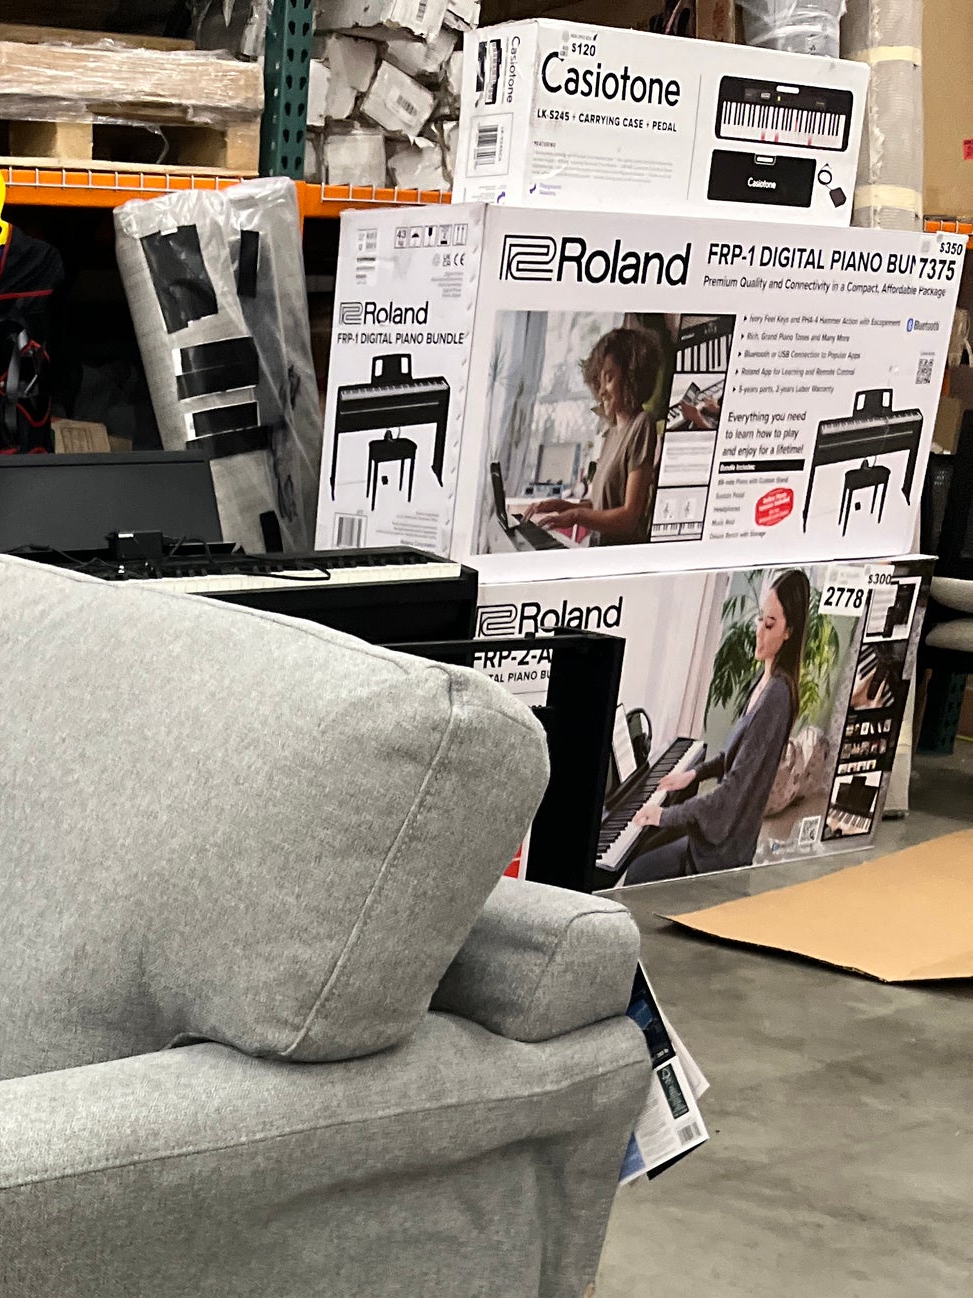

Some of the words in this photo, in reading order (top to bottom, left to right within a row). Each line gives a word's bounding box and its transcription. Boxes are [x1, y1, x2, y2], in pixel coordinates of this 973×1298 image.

[571, 42, 596, 57] $120
[506, 35, 521, 103] Casiotone
[541, 51, 681, 107] Casiotone
[578, 113, 620, 127] CARRYING
[622, 118, 644, 129] CASE
[652, 121, 677, 132] PEDAL
[747, 177, 777, 189] Casiotone
[939, 241, 964, 256] $350
[556, 237, 692, 286] Roland
[707, 242, 755, 266] FRP-1
[759, 246, 825, 270] DIGITAL
[830, 250, 883, 272] PIANO
[918, 257, 956, 281] 7375
[703, 275, 738, 287] Premium
[740, 276, 767, 291] Quality
[768, 279, 783, 289] and
[785, 279, 830, 294] Connectivity
[832, 281, 838, 291] in
[840, 283, 845, 291] a
[881, 283, 917, 295] Affordable
[918, 287, 946, 298] Package
[363, 301, 429, 325] Roland
[337, 333, 359, 344] FRP-1
[360, 333, 393, 344] DIGITAL
[395, 333, 423, 344] PIANO
[426, 333, 464, 344] BUNDLE
[821, 334, 835, 343] Many
[836, 334, 850, 342] More
[847, 352, 861, 360] Apps
[727, 411, 769, 424] Everything
[771, 413, 785, 424] you
[787, 411, 807, 421] need
[725, 430, 733, 439] to
[735, 430, 754, 439] learn
[757, 429, 772, 438] how
[774, 429, 782, 438] to
[783, 428, 799, 440] play
[722, 446, 737, 456] and
[737, 446, 757, 458] enjoy
[759, 445, 769, 455] for
[770, 447, 775, 455] a
[867, 573, 892, 584] $300
[823, 586, 865, 608] 2778
[518, 596, 623, 634] Roland
[508, 671, 538, 682] PIANO
